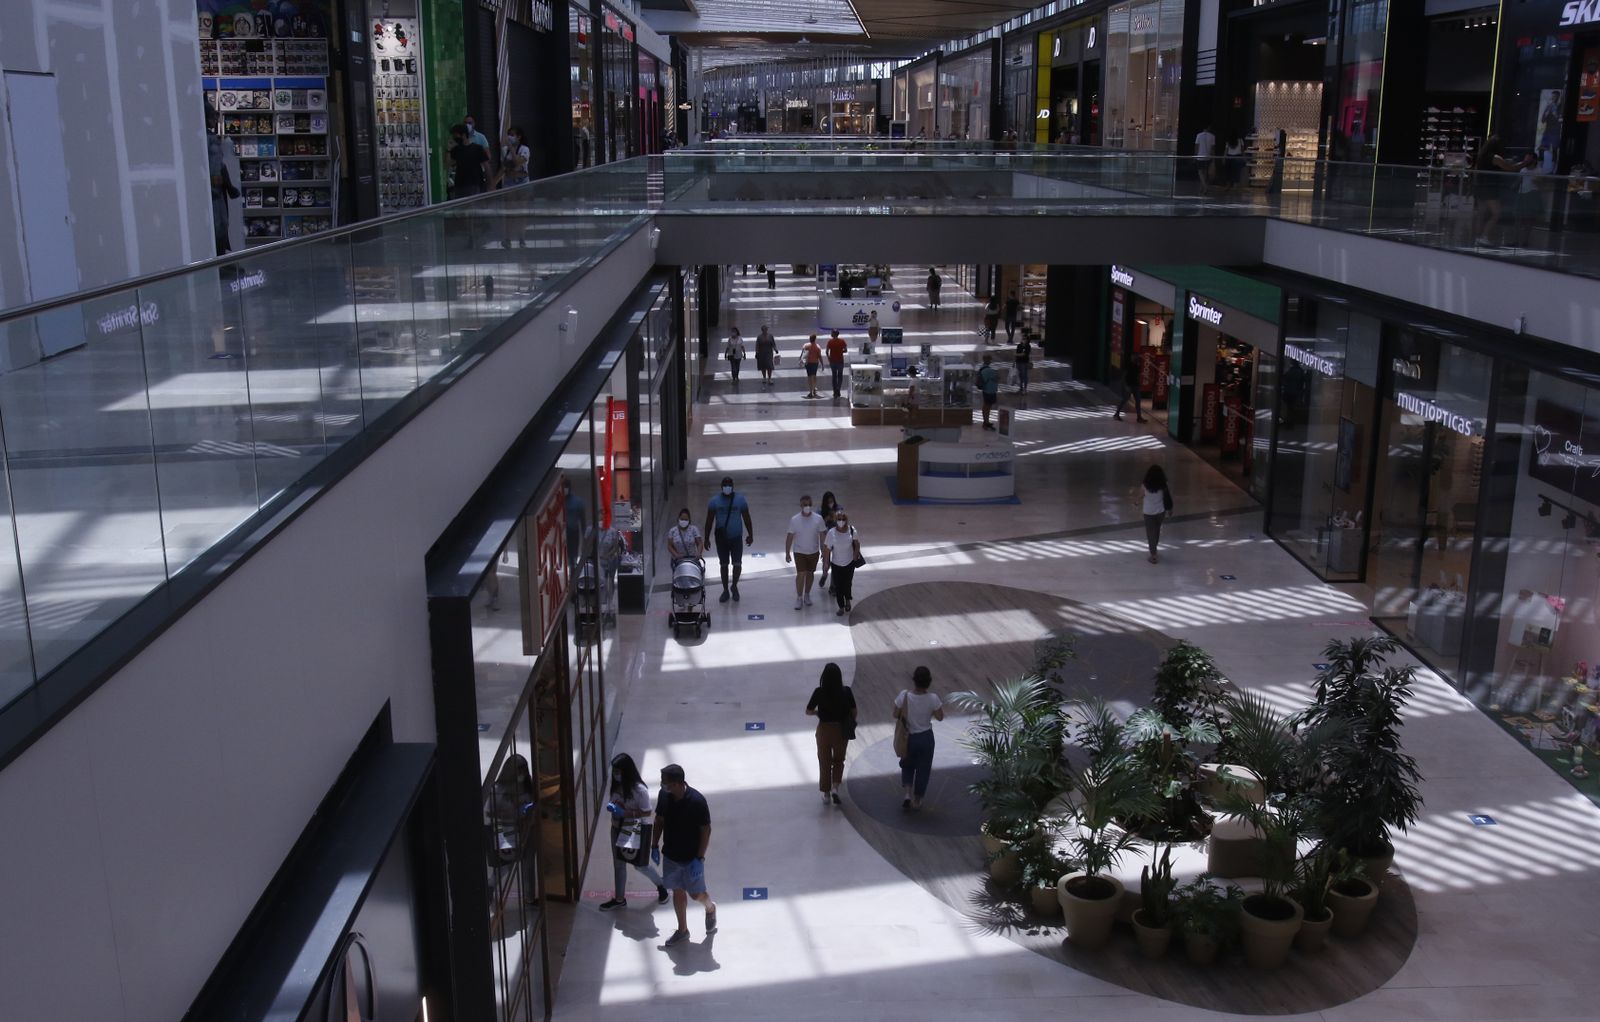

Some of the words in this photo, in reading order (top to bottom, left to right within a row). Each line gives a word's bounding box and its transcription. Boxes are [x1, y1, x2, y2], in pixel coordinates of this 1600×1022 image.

[1036, 108, 1050, 119] JD
[1111, 264, 1134, 287] Sprinter
[1189, 296, 1223, 325] Sprinter
